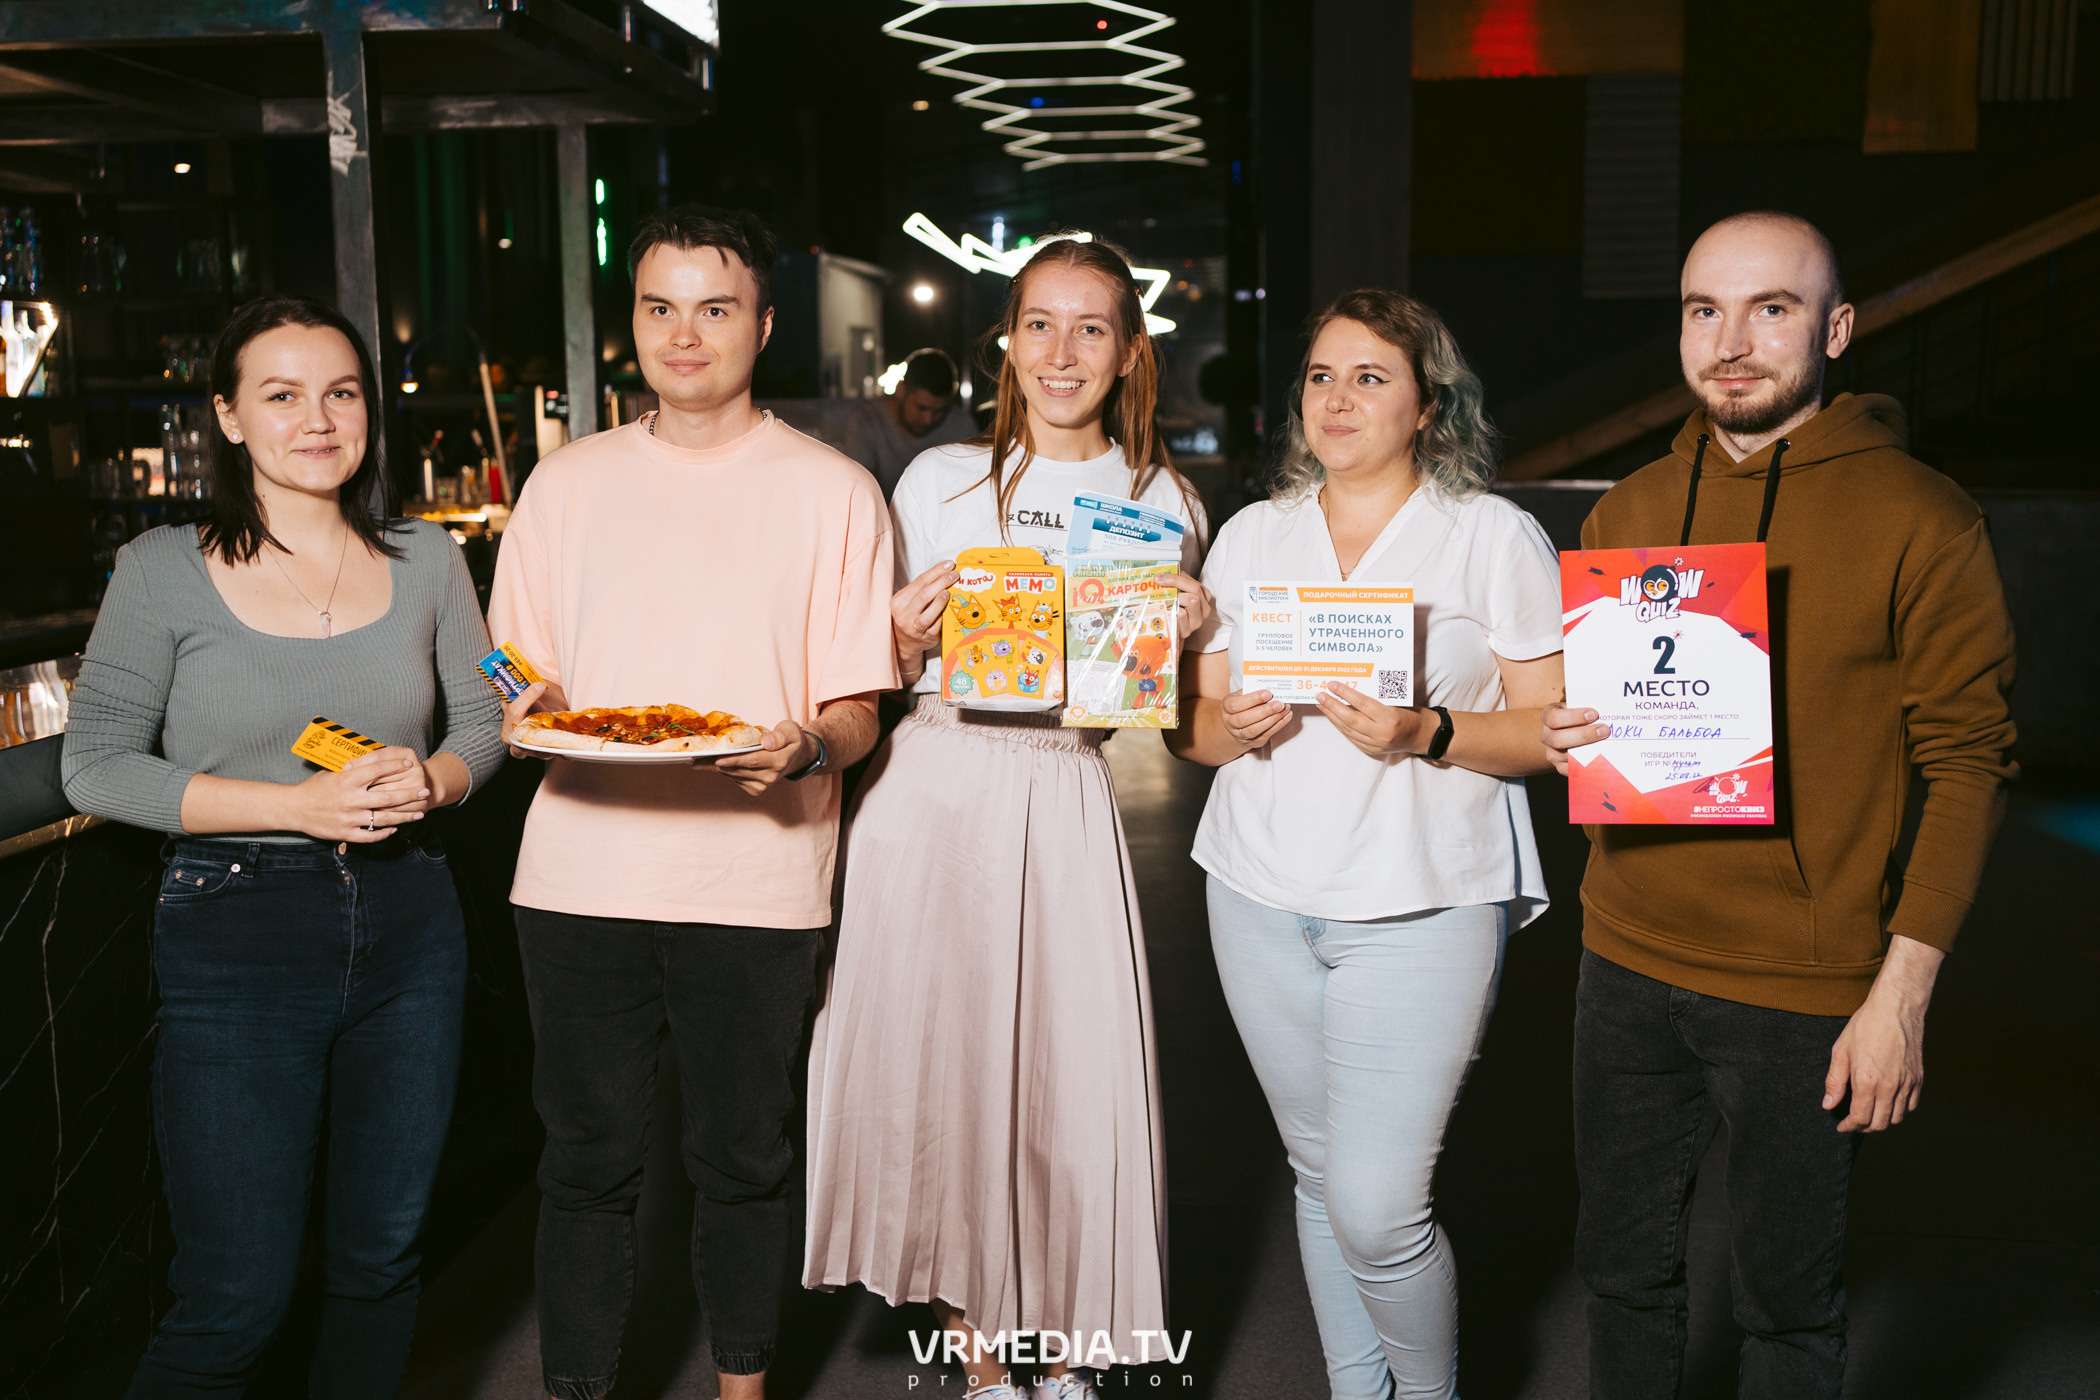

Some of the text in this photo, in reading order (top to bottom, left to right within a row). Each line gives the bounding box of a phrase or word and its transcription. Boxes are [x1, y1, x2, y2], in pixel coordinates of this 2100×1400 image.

[1018, 510, 1064, 528] CALL
[1109, 525, 1145, 539] ДЕПОЗИТ
[1303, 590, 1408, 600] ПОДАРОЧНЫЙ СЕРТИФИКАТ
[1635, 597, 1681, 623] QUIZ
[1252, 613, 1292, 623] КВЕСТ
[1328, 614, 1392, 624] ПОИСКАХ
[1309, 628, 1404, 639] УТРАЧЕННОГО
[1308, 642, 1383, 653] СИМВОЛА»
[1652, 635, 1676, 674] 2
[1248, 664, 1293, 672] ДЕЙСТВИТЕЛЕН
[491, 660, 525, 696] ЕРТИФИКАТ
[1623, 680, 1710, 698] МЕСТО
